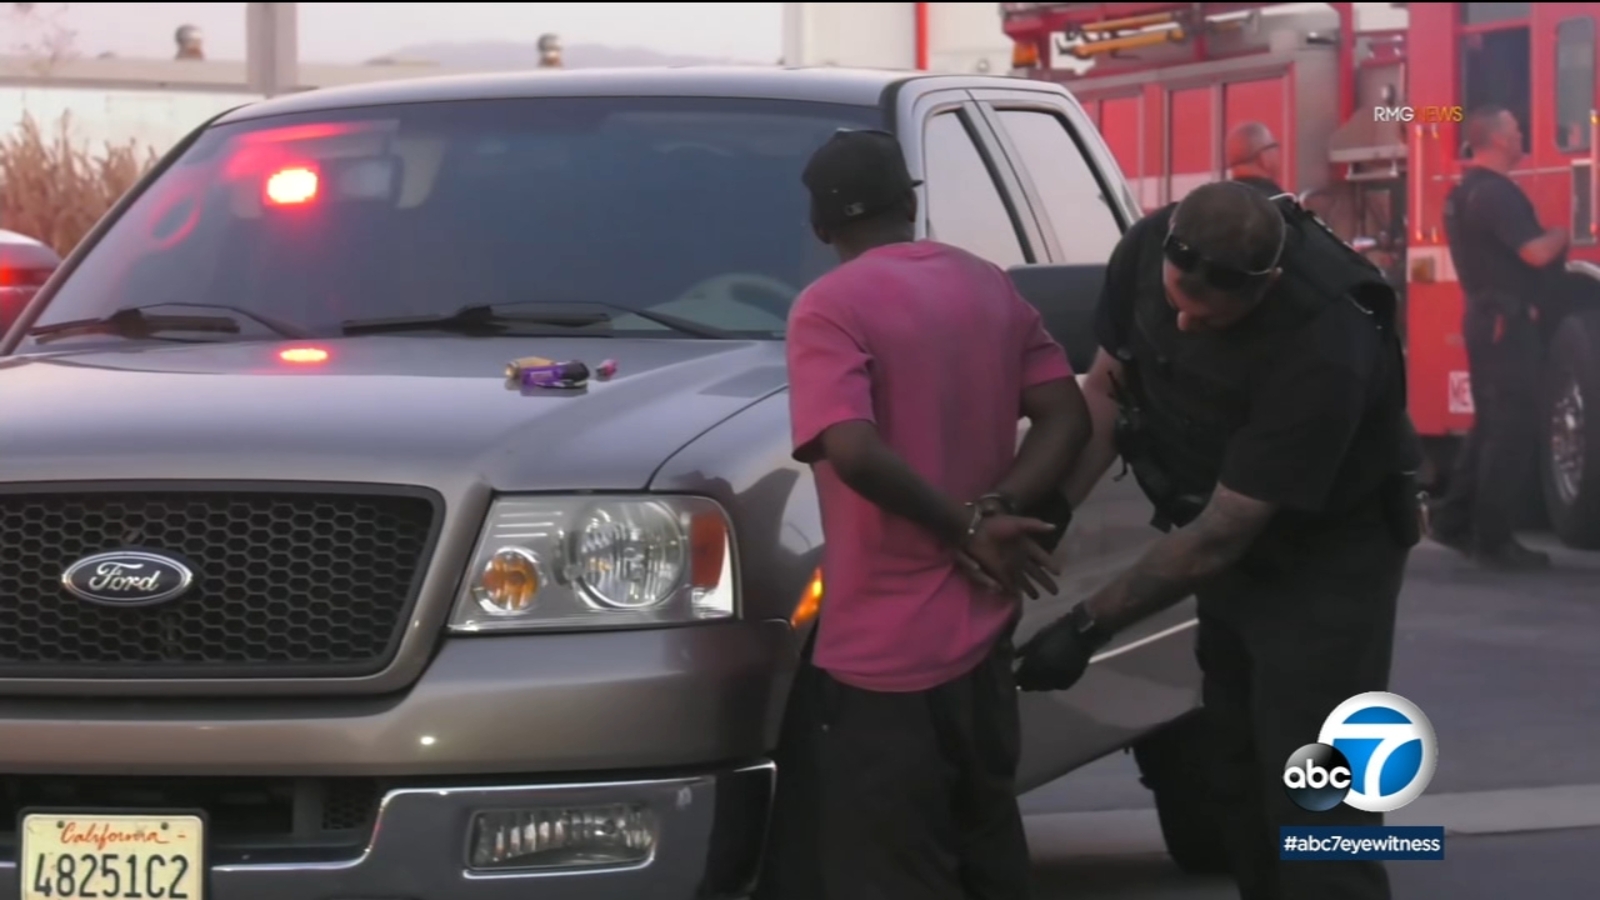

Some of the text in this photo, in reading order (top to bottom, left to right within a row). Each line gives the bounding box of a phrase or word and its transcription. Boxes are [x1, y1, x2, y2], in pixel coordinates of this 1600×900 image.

[88, 562, 161, 591] Ford
[60, 822, 170, 850] California
[33, 853, 188, 899] 48251C2
